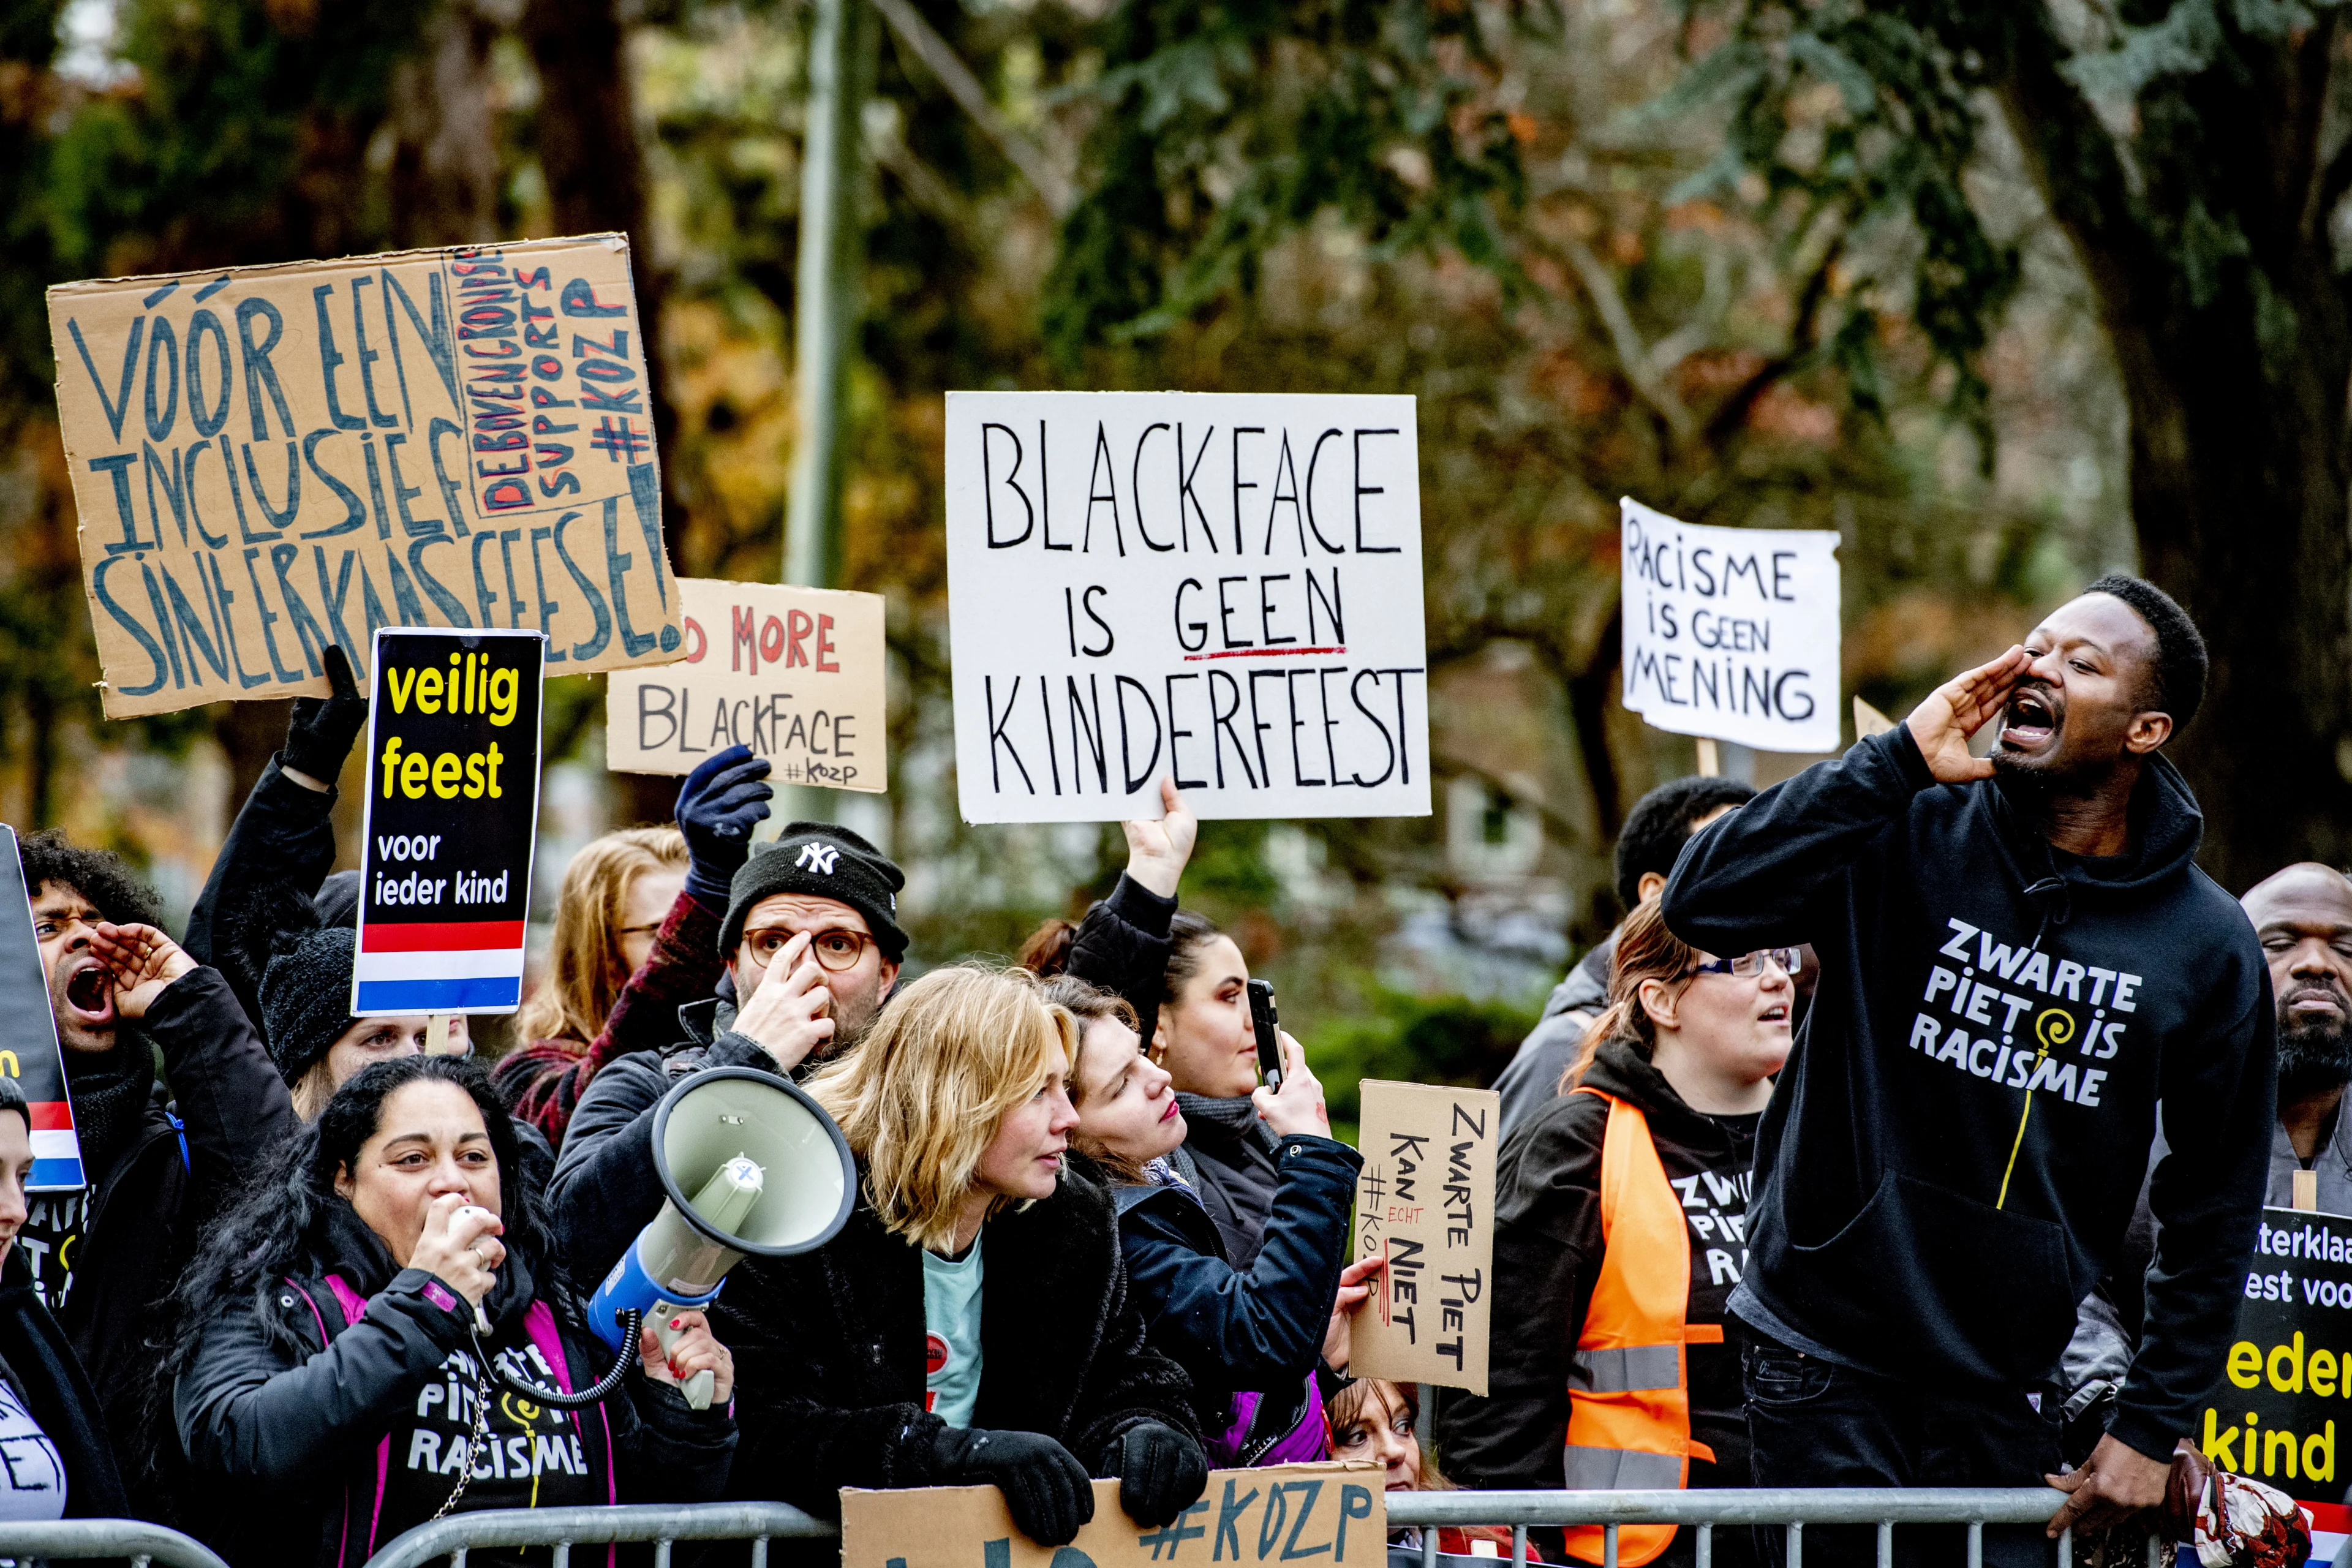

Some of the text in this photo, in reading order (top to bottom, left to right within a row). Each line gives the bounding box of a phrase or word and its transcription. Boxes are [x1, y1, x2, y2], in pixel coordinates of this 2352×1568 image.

[67, 268, 464, 443] VÓÓR EEN
[513, 266, 581, 498] SUPPORTS
[560, 278, 649, 464] #KOZP
[982, 419, 1401, 557] BLACKFACE
[733, 605, 840, 675] MORE
[1065, 567, 1345, 657] IS GEEN
[1692, 609, 1770, 653] GEEN
[388, 652, 519, 727] veilig
[638, 684, 856, 757] BLACKFACE
[381, 737, 503, 799] feest
[984, 667, 1425, 796] KINDERFEEST
[375, 870, 508, 905] ieder kind
[377, 832, 441, 861] voor
[796, 842, 840, 875] NY
[1939, 918, 2143, 1012] ZWARTE
[1388, 1133, 1430, 1344] KAN ECHT NIET
[1436, 1102, 1486, 1371] ZWARTE PIET
[2203, 1408, 2335, 1482] kind
